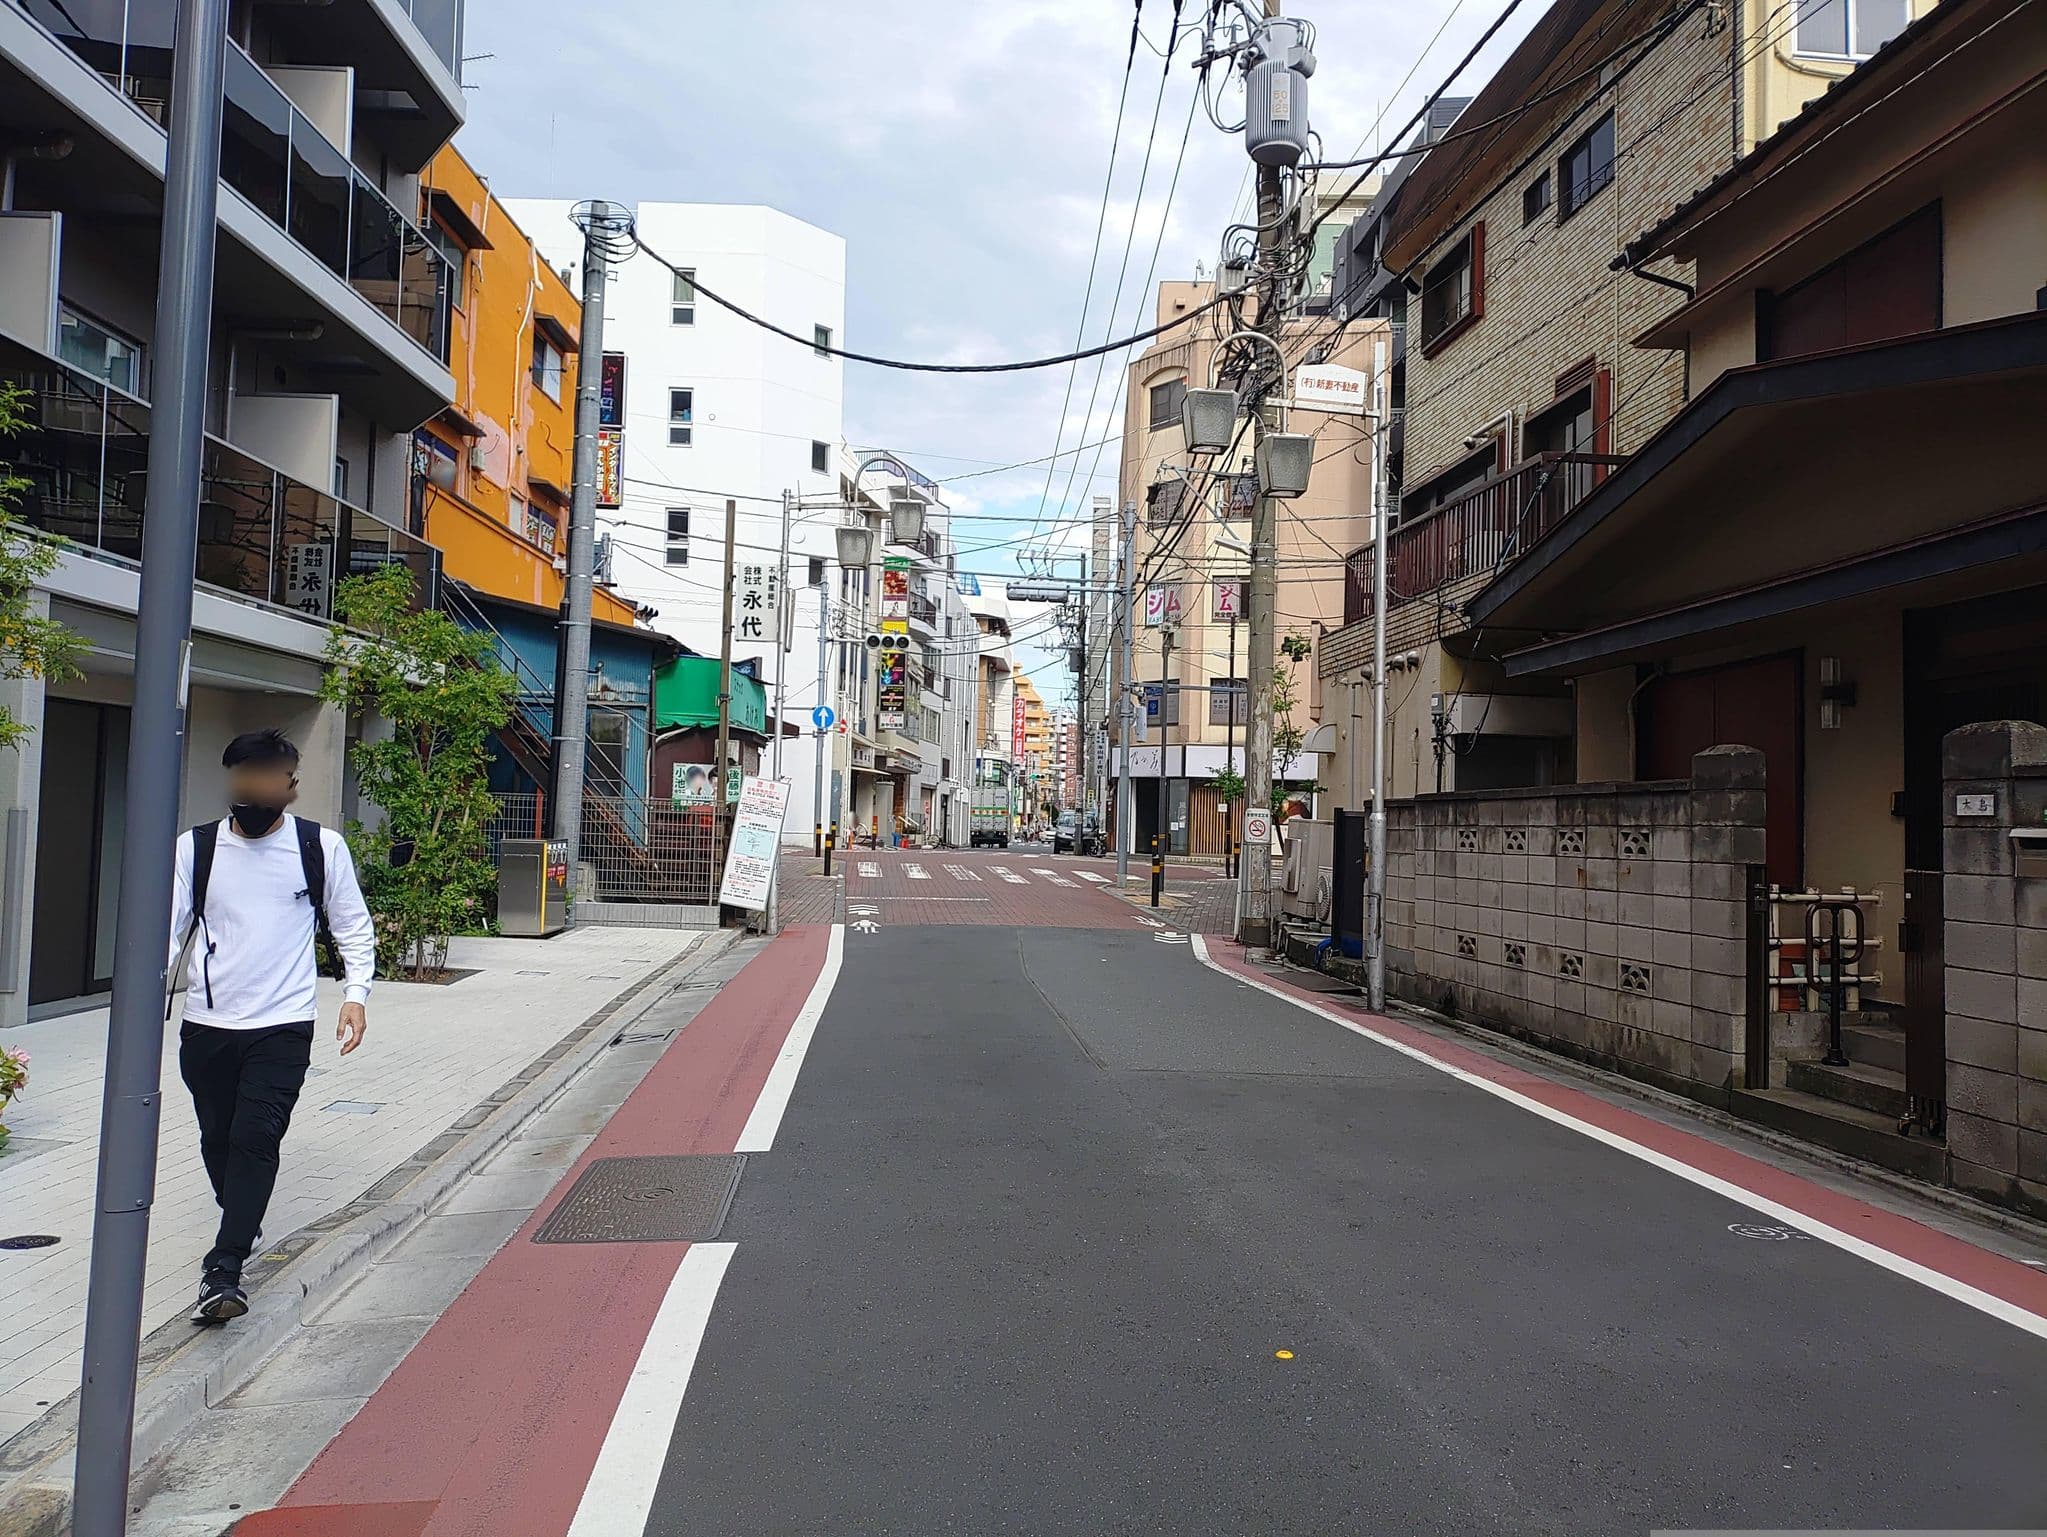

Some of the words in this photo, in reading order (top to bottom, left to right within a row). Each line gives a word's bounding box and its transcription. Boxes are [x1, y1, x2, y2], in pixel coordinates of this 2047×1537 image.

[1149, 590, 1181, 615] ジム
[1220, 584, 1233, 610] ジム
[742, 590, 762, 637] 永代
[1015, 700, 1024, 737] カラオケ
[675, 768, 686, 788] 小池
[728, 770, 740, 790] 後藤
